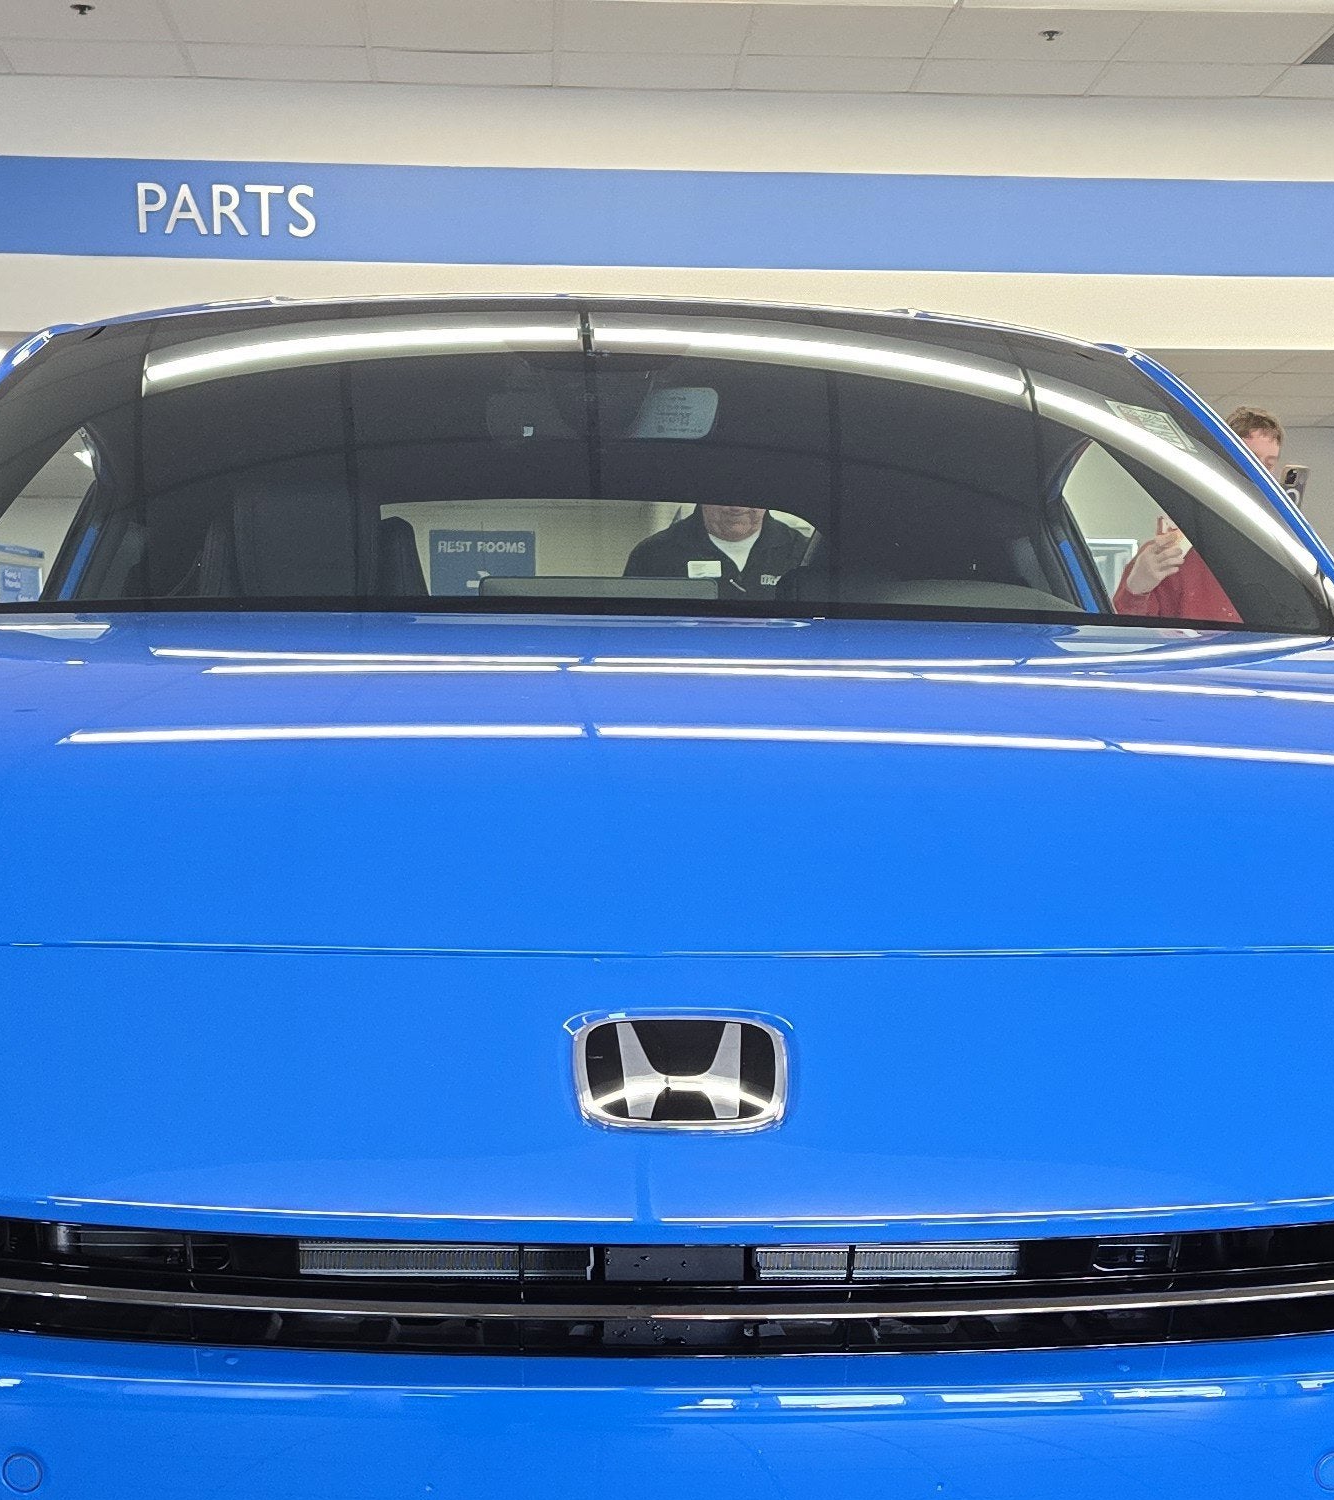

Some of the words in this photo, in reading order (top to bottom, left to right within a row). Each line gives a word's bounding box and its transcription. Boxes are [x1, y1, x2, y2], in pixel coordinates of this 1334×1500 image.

[137, 182, 317, 238] PARTS
[437, 541, 473, 553] REST
[477, 541, 526, 554] ROOMS
